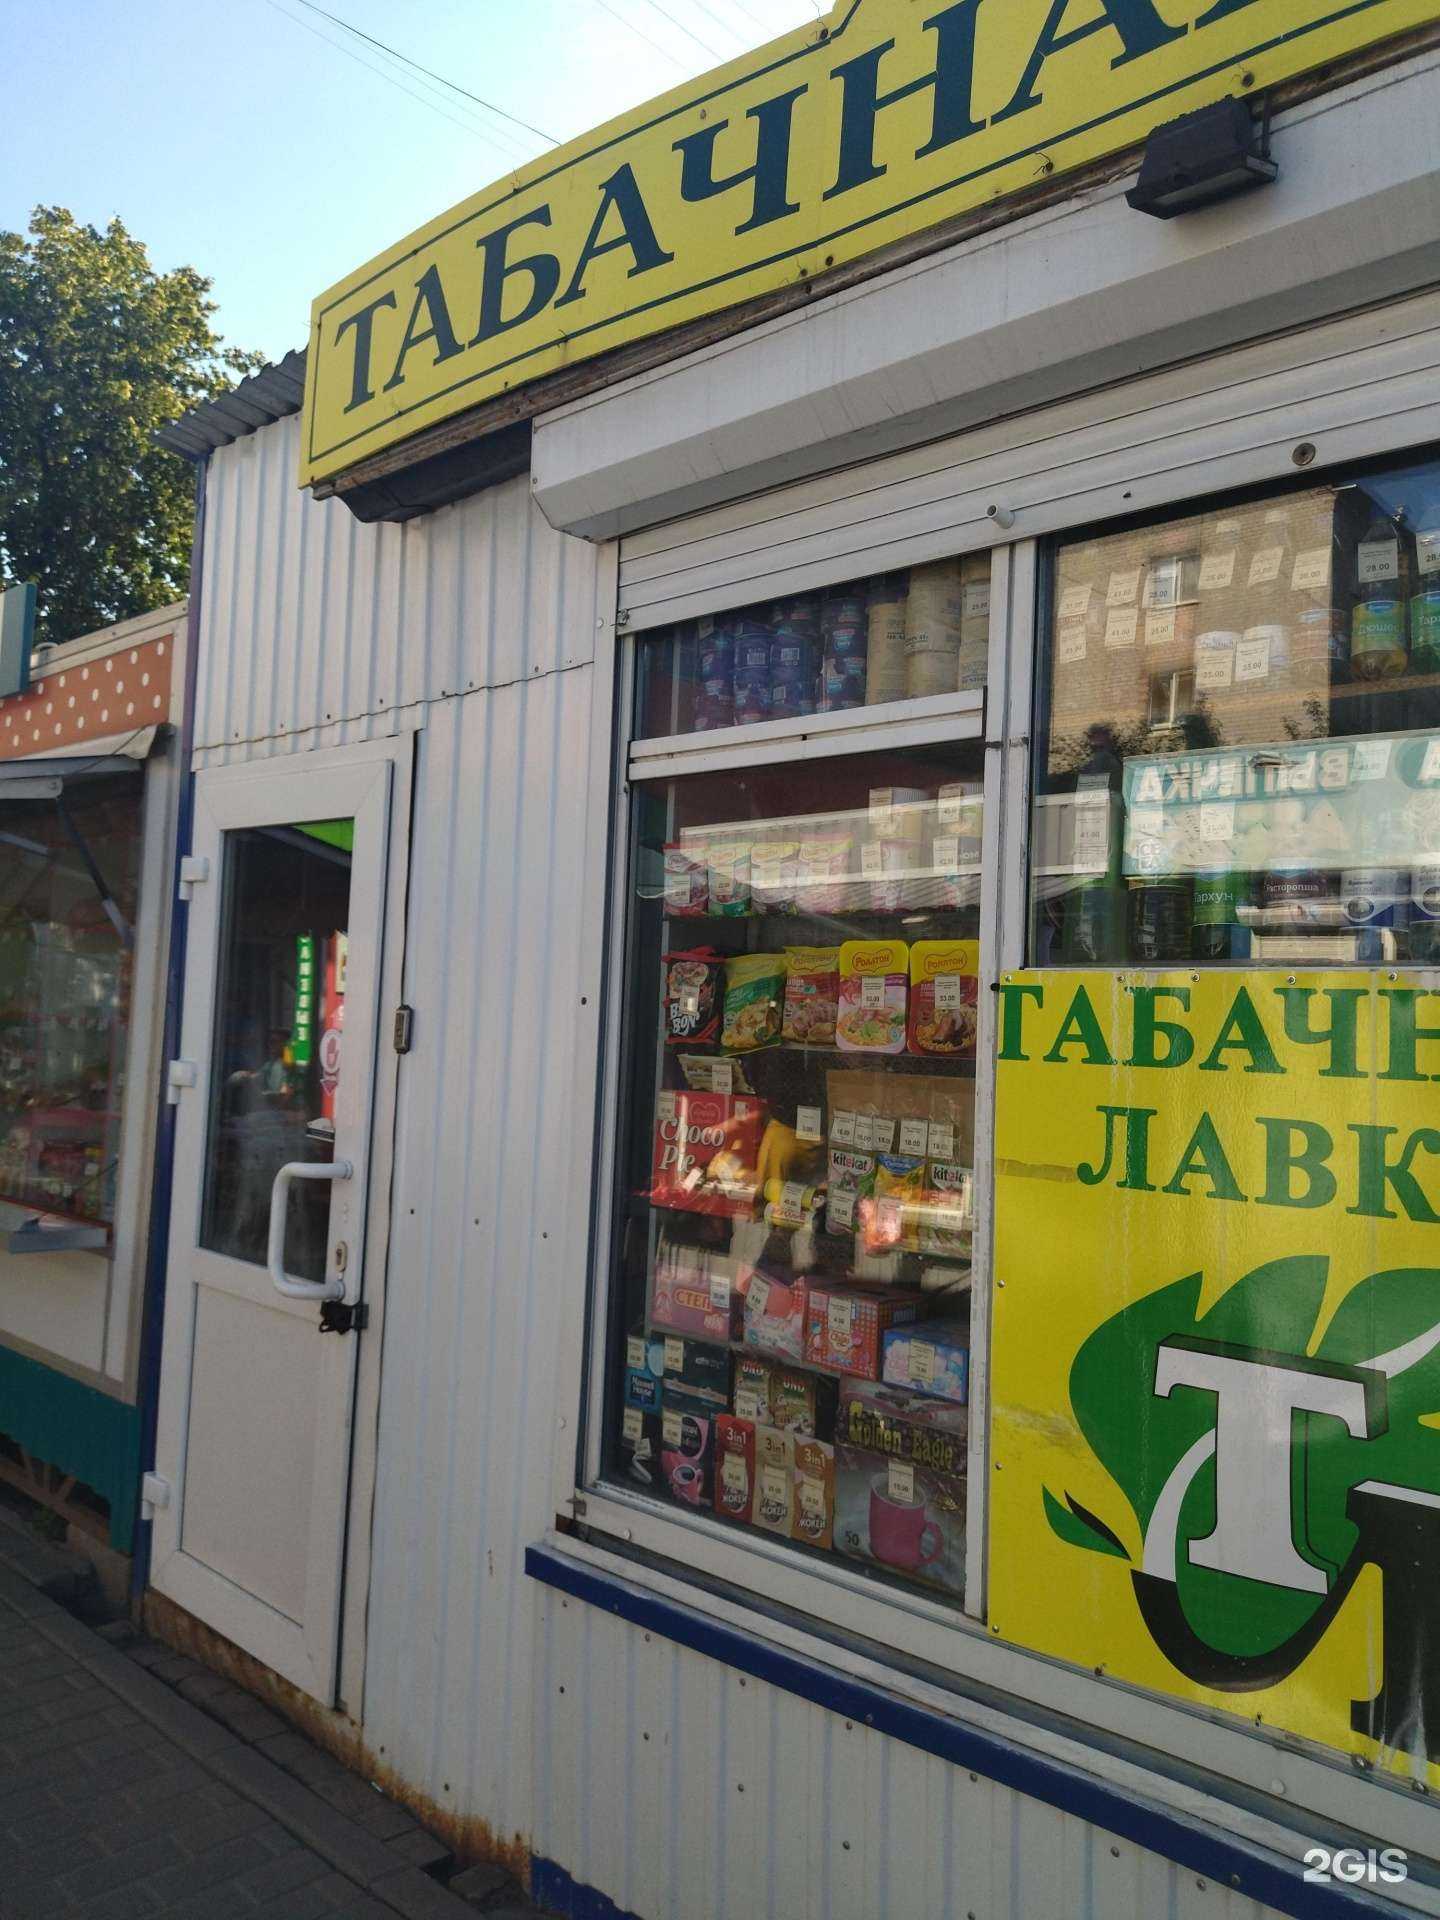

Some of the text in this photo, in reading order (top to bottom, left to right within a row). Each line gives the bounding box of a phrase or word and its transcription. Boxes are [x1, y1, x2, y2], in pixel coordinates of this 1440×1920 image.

[333, 0, 1260, 411] ТАБАЧНА
[1365, 562, 1390, 573] 28.00
[660, 1119, 725, 1148] Choco
[832, 1152, 868, 1172] kitekat
[1077, 1105, 1440, 1223] ЛАВК
[725, 1428, 748, 1446] 3in1
[764, 1437, 787, 1456] 3in1
[804, 1448, 827, 1468] 3in1
